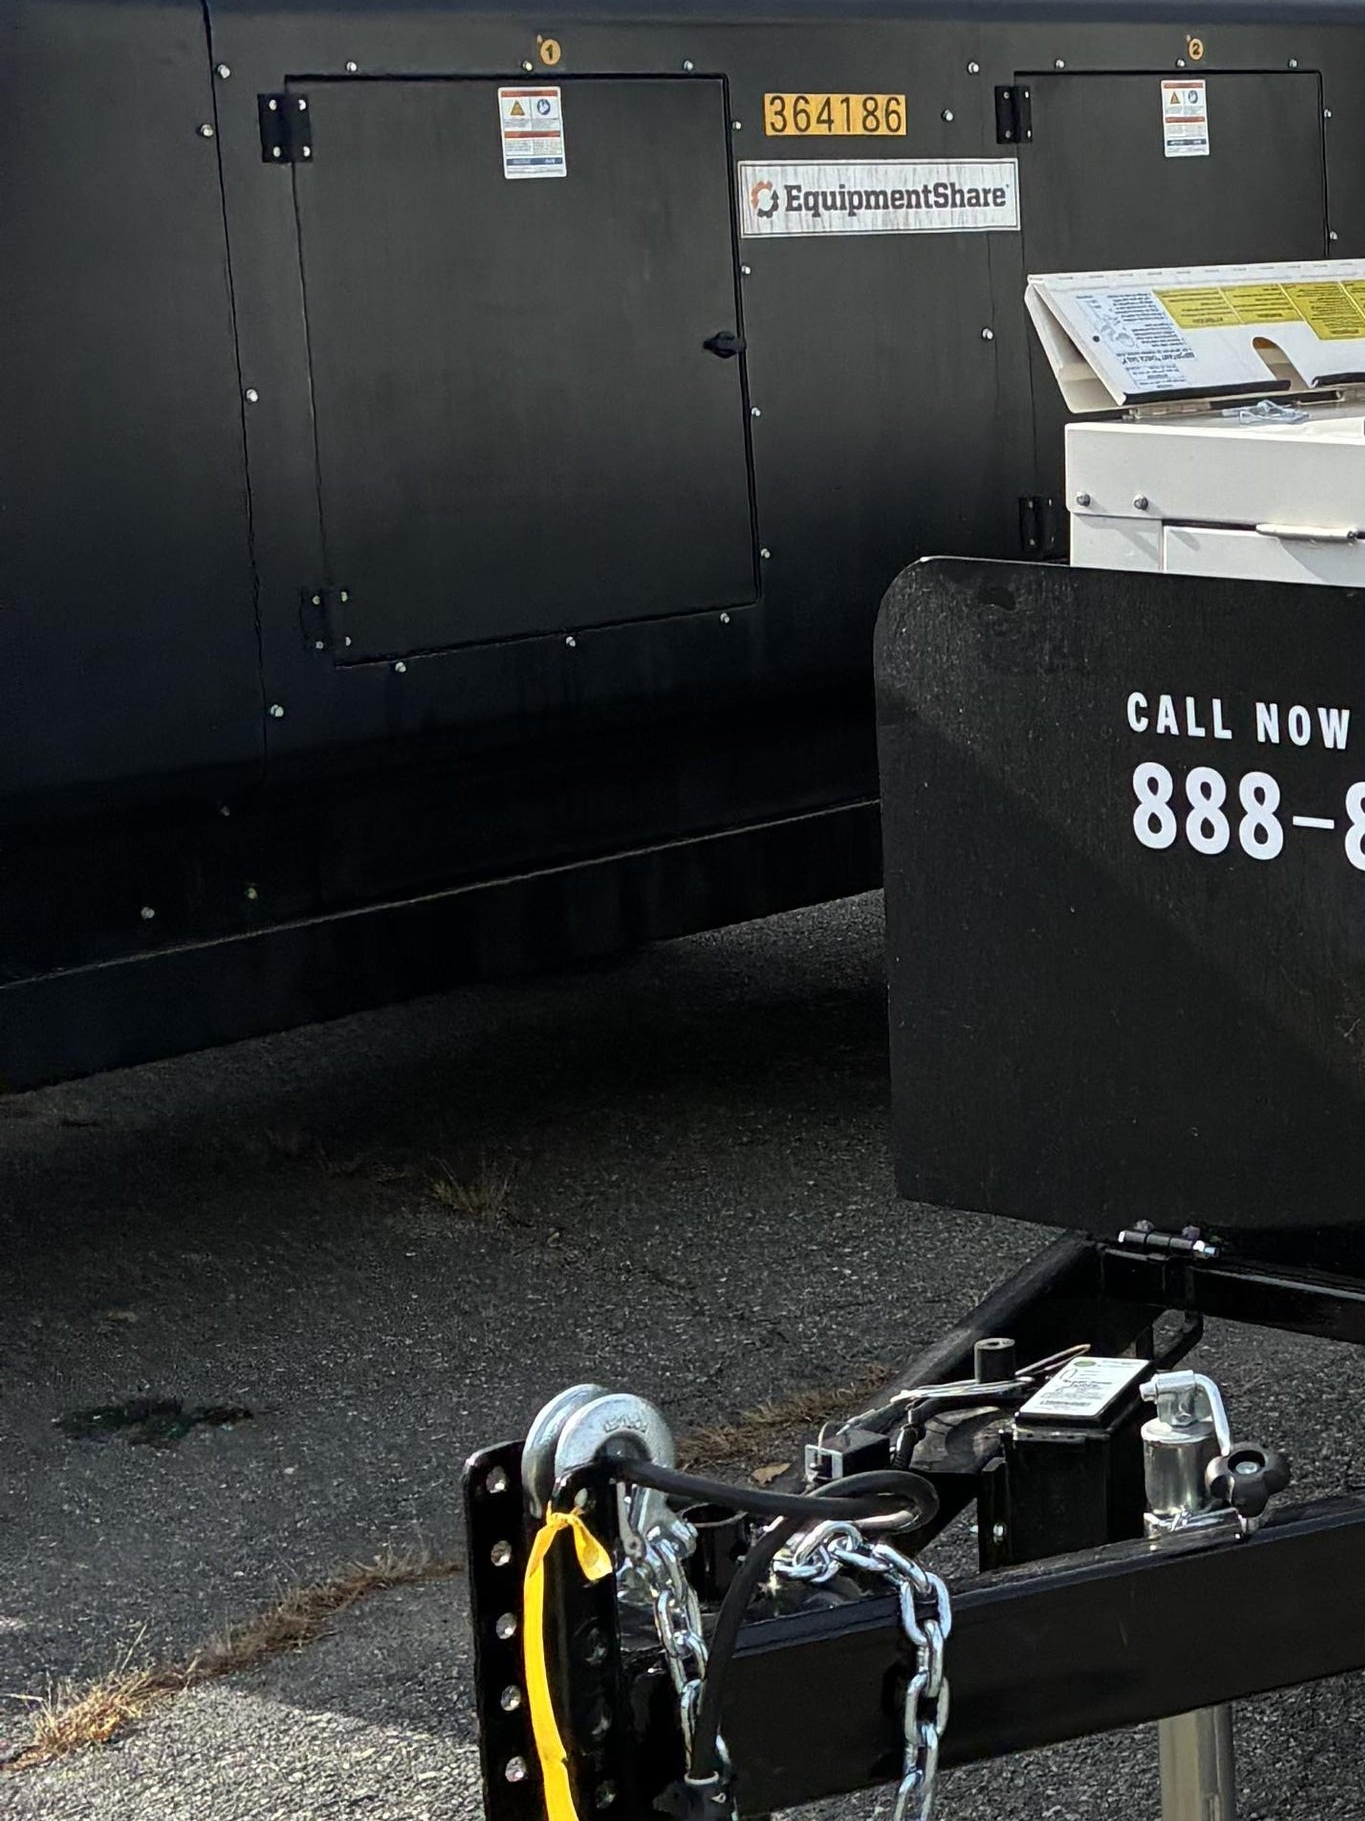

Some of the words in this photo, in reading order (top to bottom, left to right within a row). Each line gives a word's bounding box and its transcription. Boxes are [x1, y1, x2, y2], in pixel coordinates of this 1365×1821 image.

[769, 95, 902, 134] 364186
[784, 182, 1007, 218] EquipmentShare
[1126, 691, 1233, 740] CALL
[1255, 702, 1350, 750] NOW
